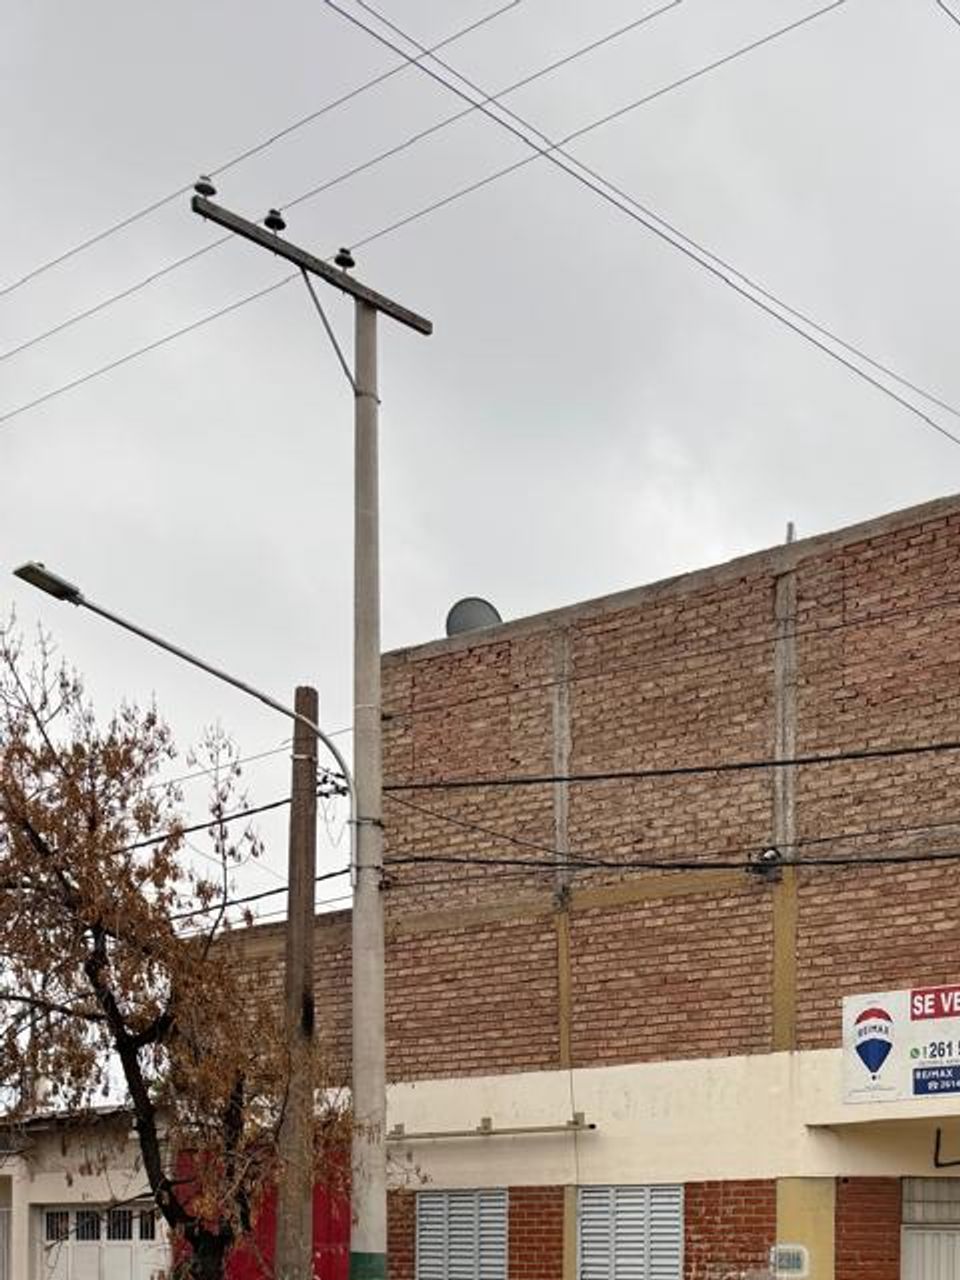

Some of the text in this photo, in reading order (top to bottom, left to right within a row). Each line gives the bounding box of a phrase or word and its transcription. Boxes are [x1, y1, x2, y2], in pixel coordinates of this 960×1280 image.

[913, 994, 935, 1015] SE
[929, 1042, 953, 1058] 261
[915, 1068, 954, 1080] RE/MAX
